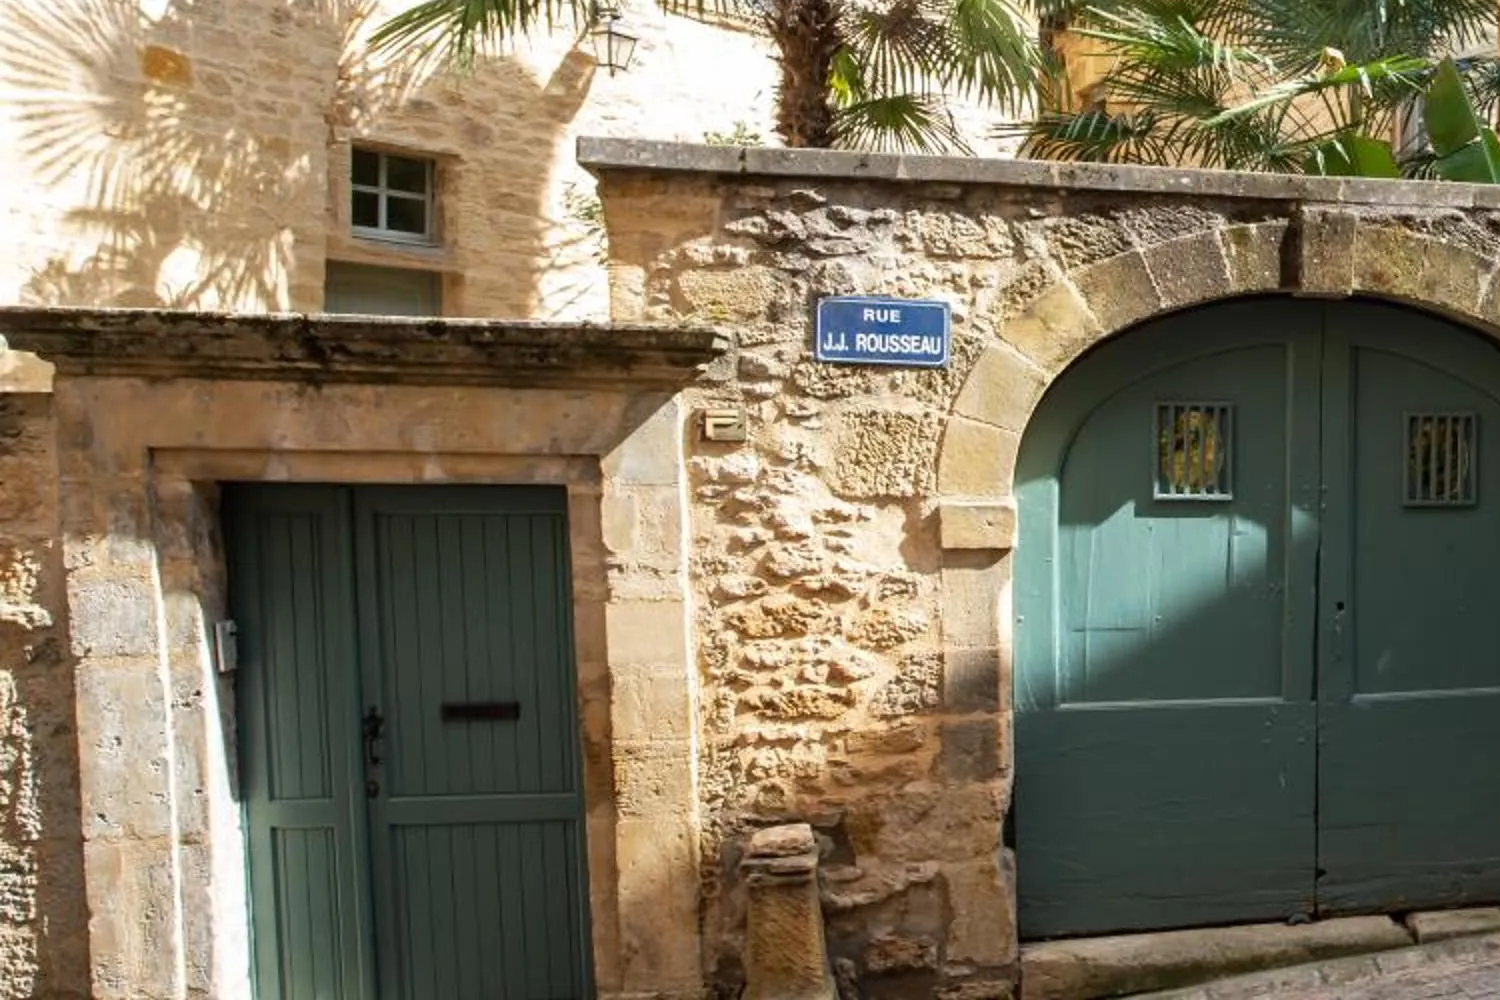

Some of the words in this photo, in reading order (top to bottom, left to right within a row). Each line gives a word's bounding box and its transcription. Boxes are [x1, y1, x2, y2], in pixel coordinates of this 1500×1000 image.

[863, 308, 902, 323] RUE
[823, 332, 849, 351] J.J.
[855, 333, 942, 355] ROUSSEAU
